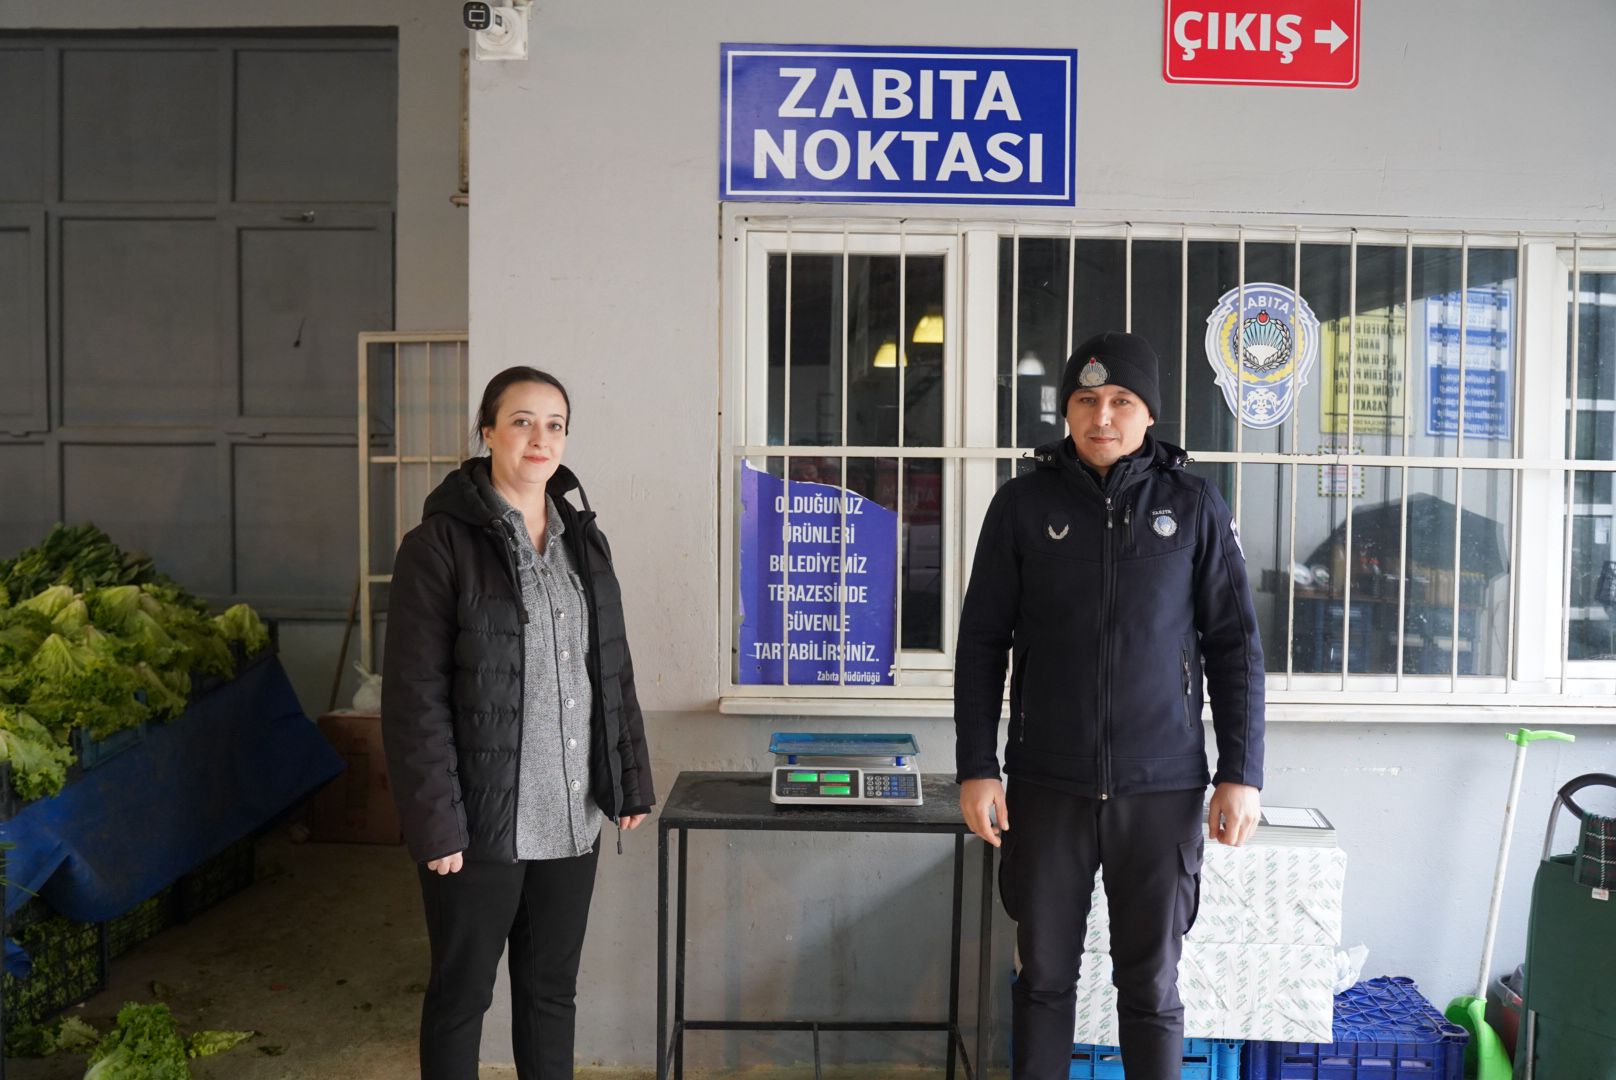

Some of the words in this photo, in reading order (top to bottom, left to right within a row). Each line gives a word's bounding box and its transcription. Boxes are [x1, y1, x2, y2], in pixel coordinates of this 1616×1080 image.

[1173, 11, 1302, 64] ÇIKIŞ
[778, 67, 1022, 121] ZABITA
[753, 128, 1044, 183] NOKTASI
[775, 493, 864, 515] OLDUĞUNUZ
